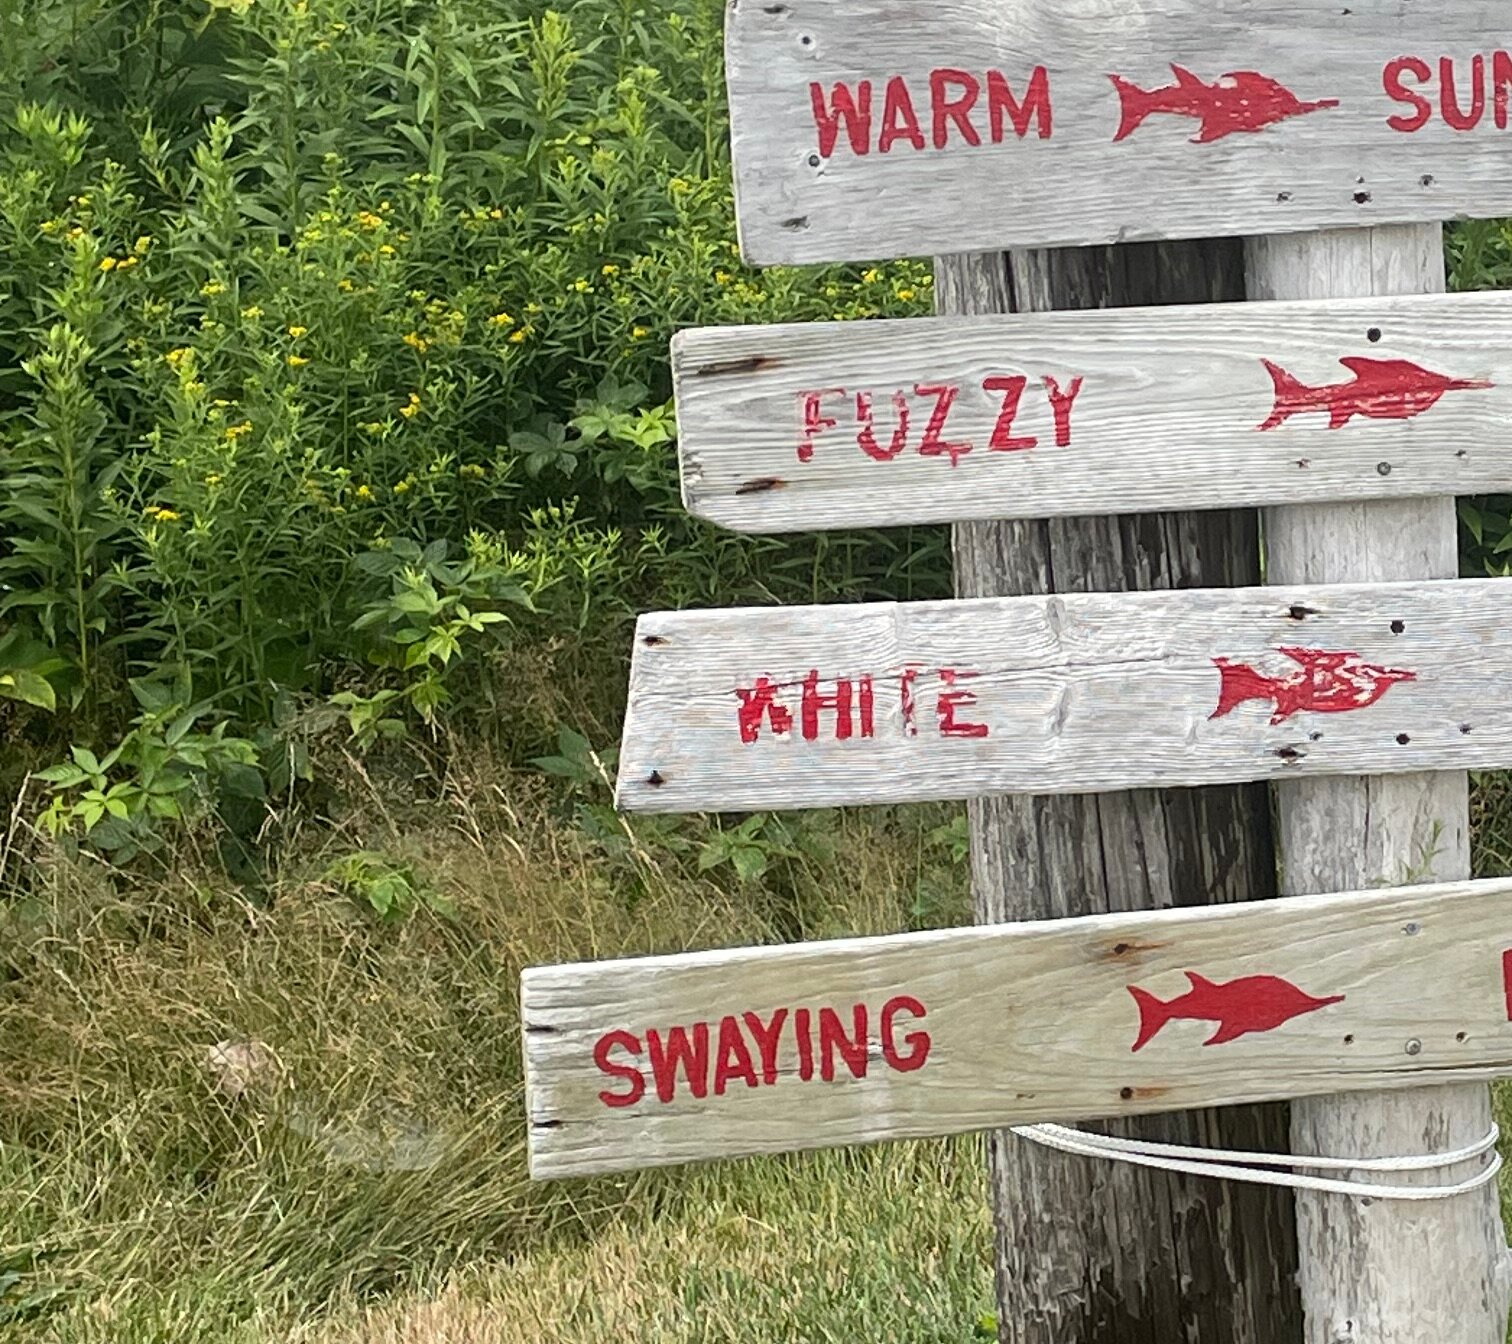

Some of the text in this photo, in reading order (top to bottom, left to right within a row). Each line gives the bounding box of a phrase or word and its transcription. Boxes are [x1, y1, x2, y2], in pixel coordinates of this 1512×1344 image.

[810, 65, 1053, 157] WARM
[796, 374, 1084, 466] FUZZY
[736, 663, 990, 744] WHITE
[592, 994, 933, 1108] SWAYING
